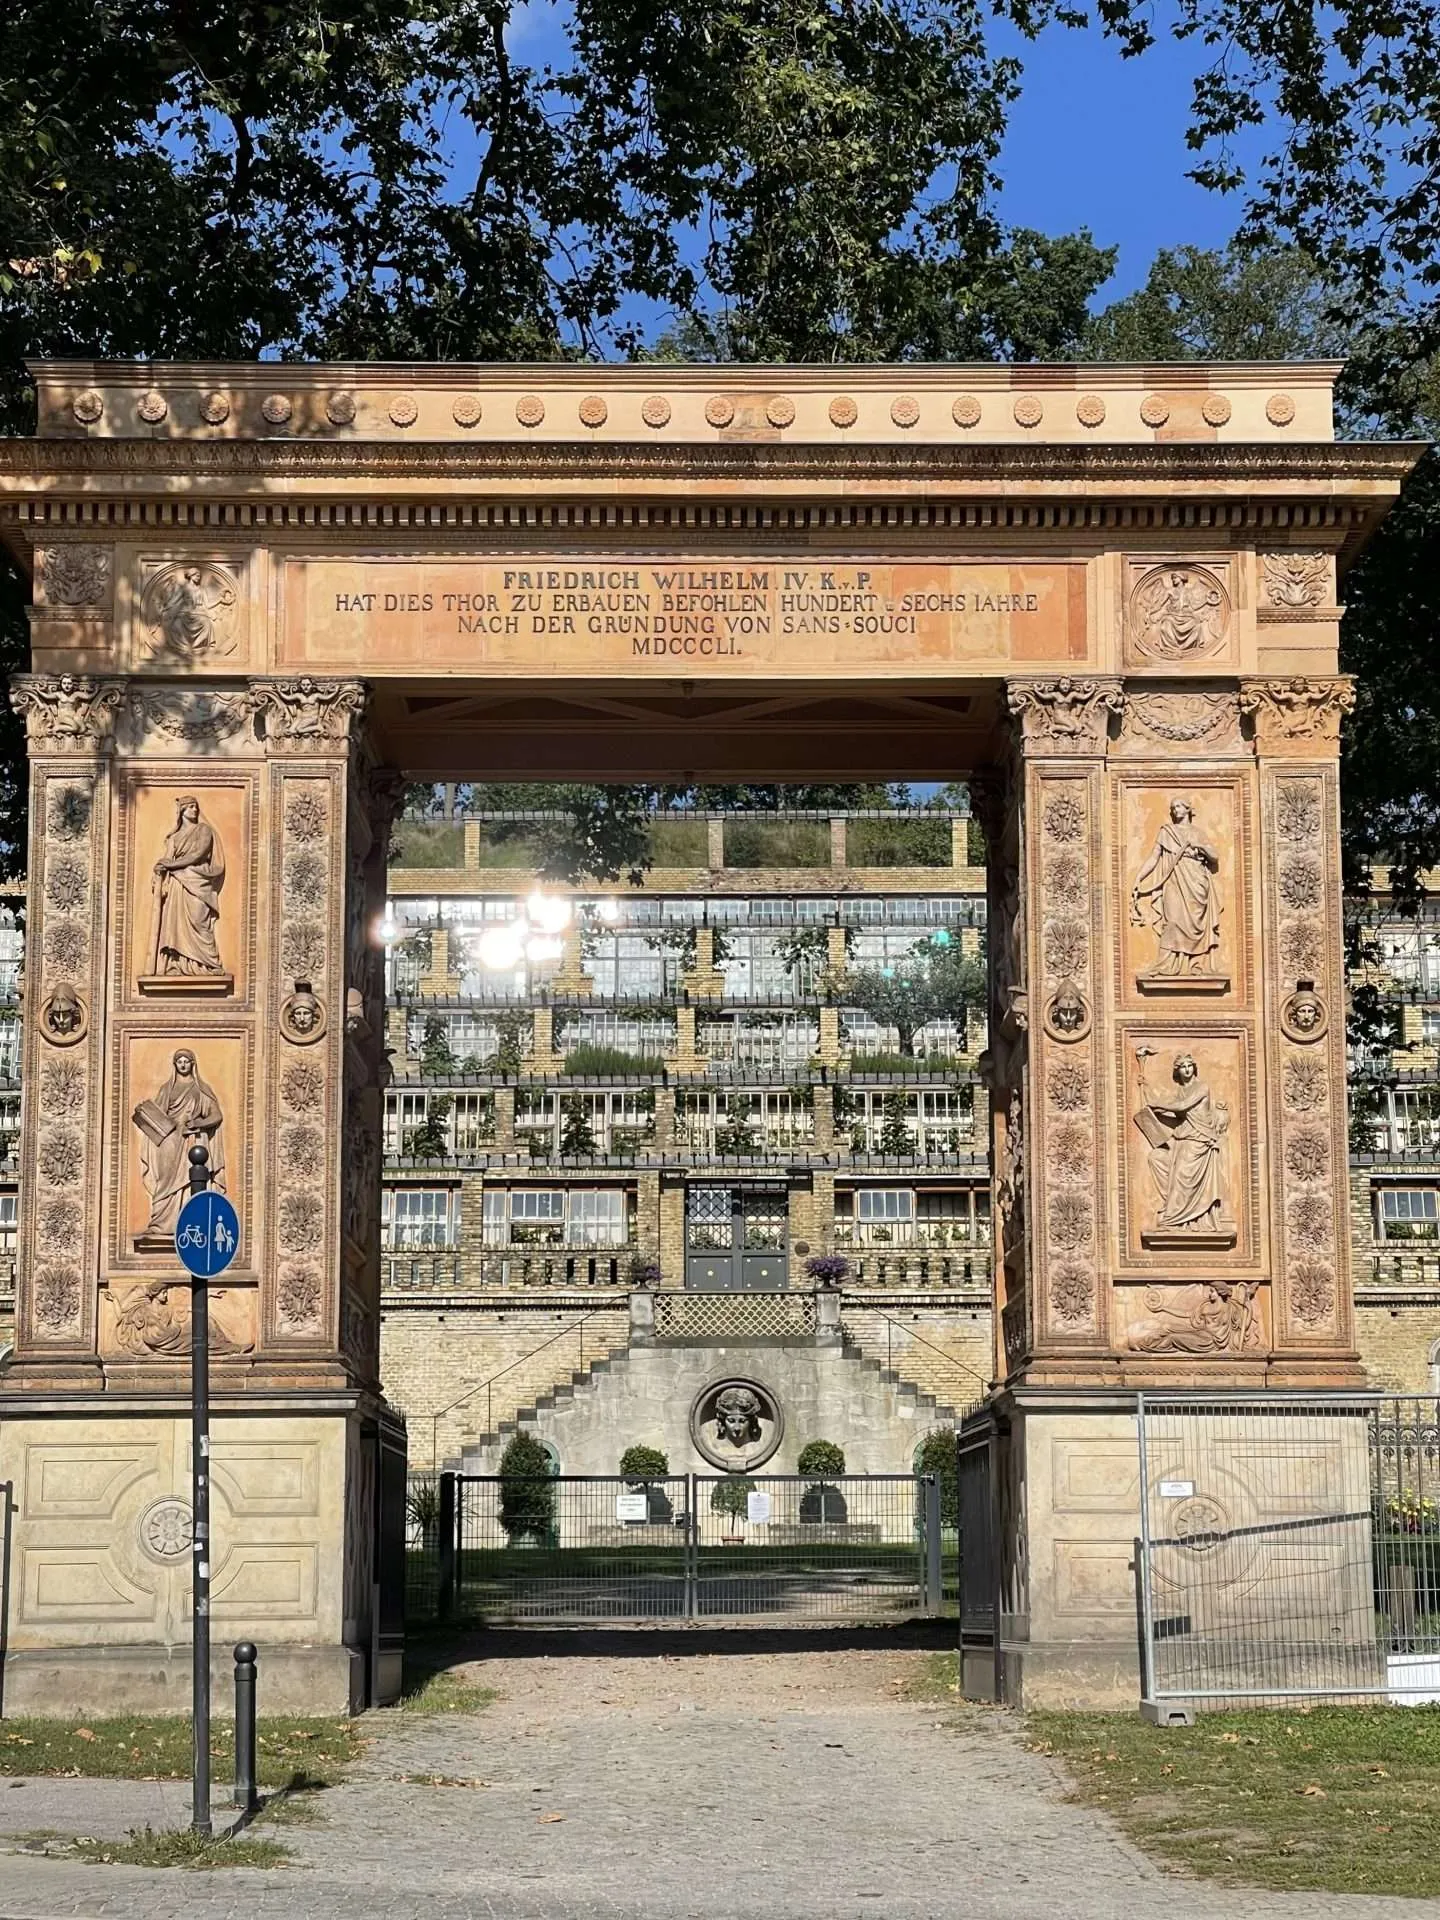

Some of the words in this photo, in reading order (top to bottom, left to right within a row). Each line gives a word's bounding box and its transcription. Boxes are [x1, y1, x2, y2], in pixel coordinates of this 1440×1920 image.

[504, 571, 640, 590] FRIEDRICH
[335, 594, 377, 612] HAT
[384, 594, 434, 612] DIES
[443, 594, 499, 612] THOR
[511, 594, 542, 612] ZU
[552, 594, 650, 612] ERBAUEN
[662, 594, 768, 612] BEFOHLEN
[780, 594, 879, 612] HUNDERT
[901, 594, 967, 612] SECHS
[458, 616, 519, 634] NACH
[532, 616, 576, 634] DER
[587, 616, 715, 634] GRÜNDUNG
[724, 616, 771, 634] VON
